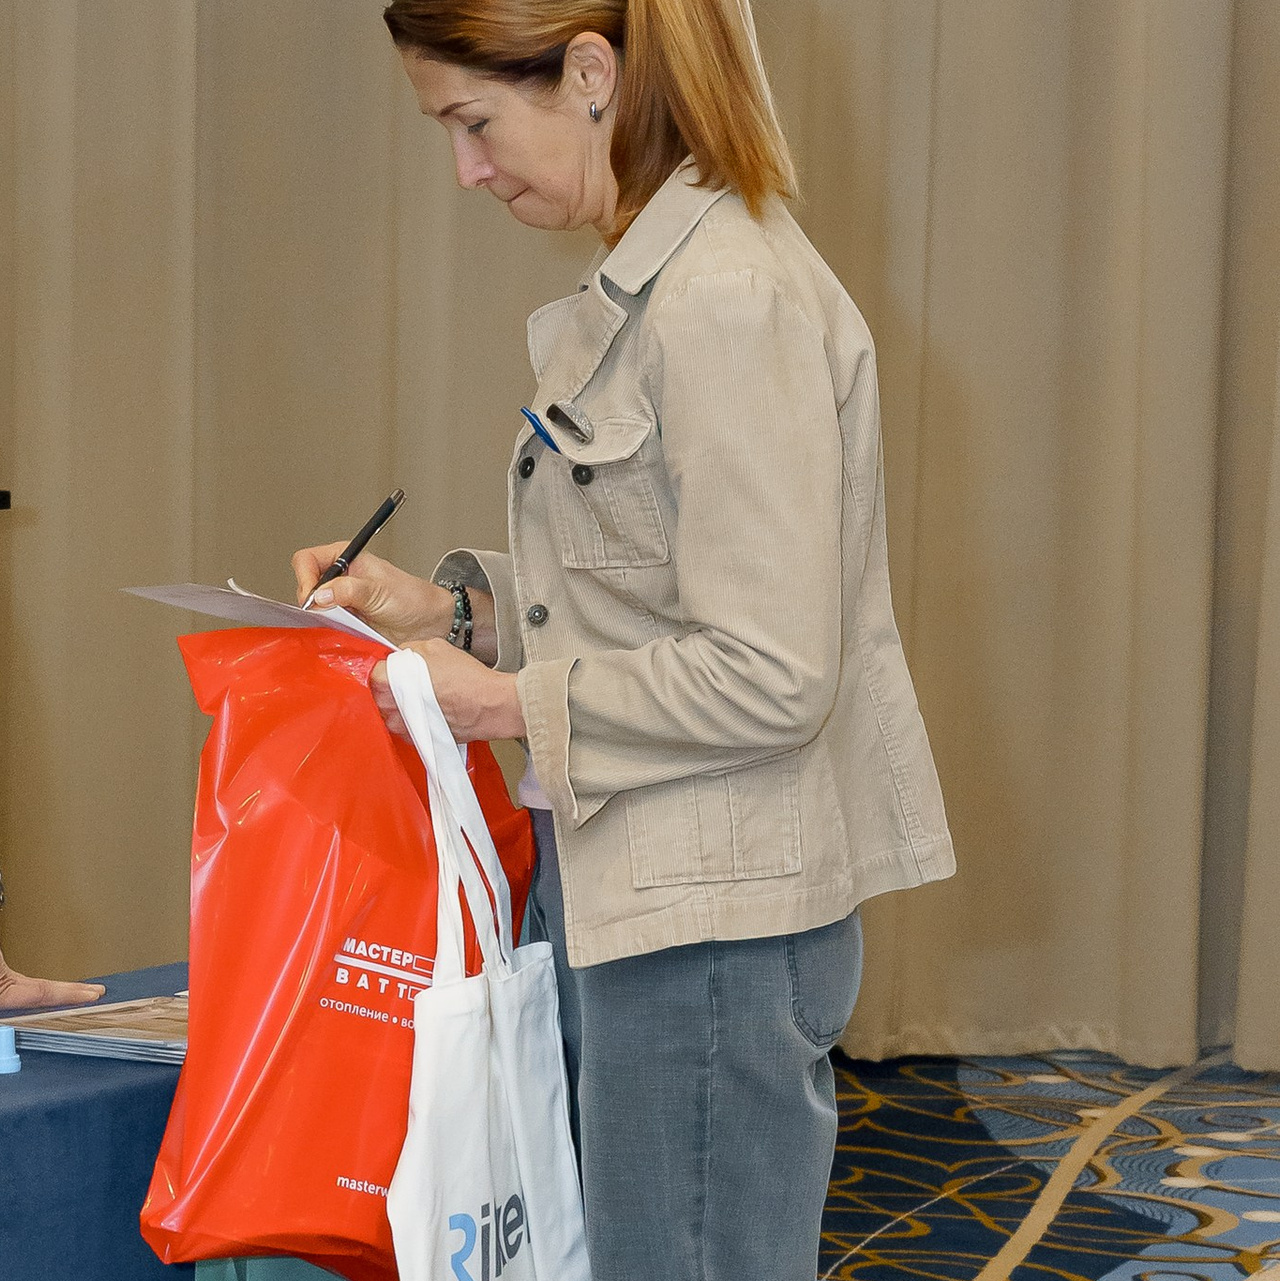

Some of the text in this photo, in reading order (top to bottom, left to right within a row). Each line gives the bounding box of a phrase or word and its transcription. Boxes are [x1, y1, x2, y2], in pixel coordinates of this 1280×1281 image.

[342, 937, 414, 968] МАСТЕР
[335, 967, 408, 1000] ВАТТ
[319, 997, 389, 1023] отопление
